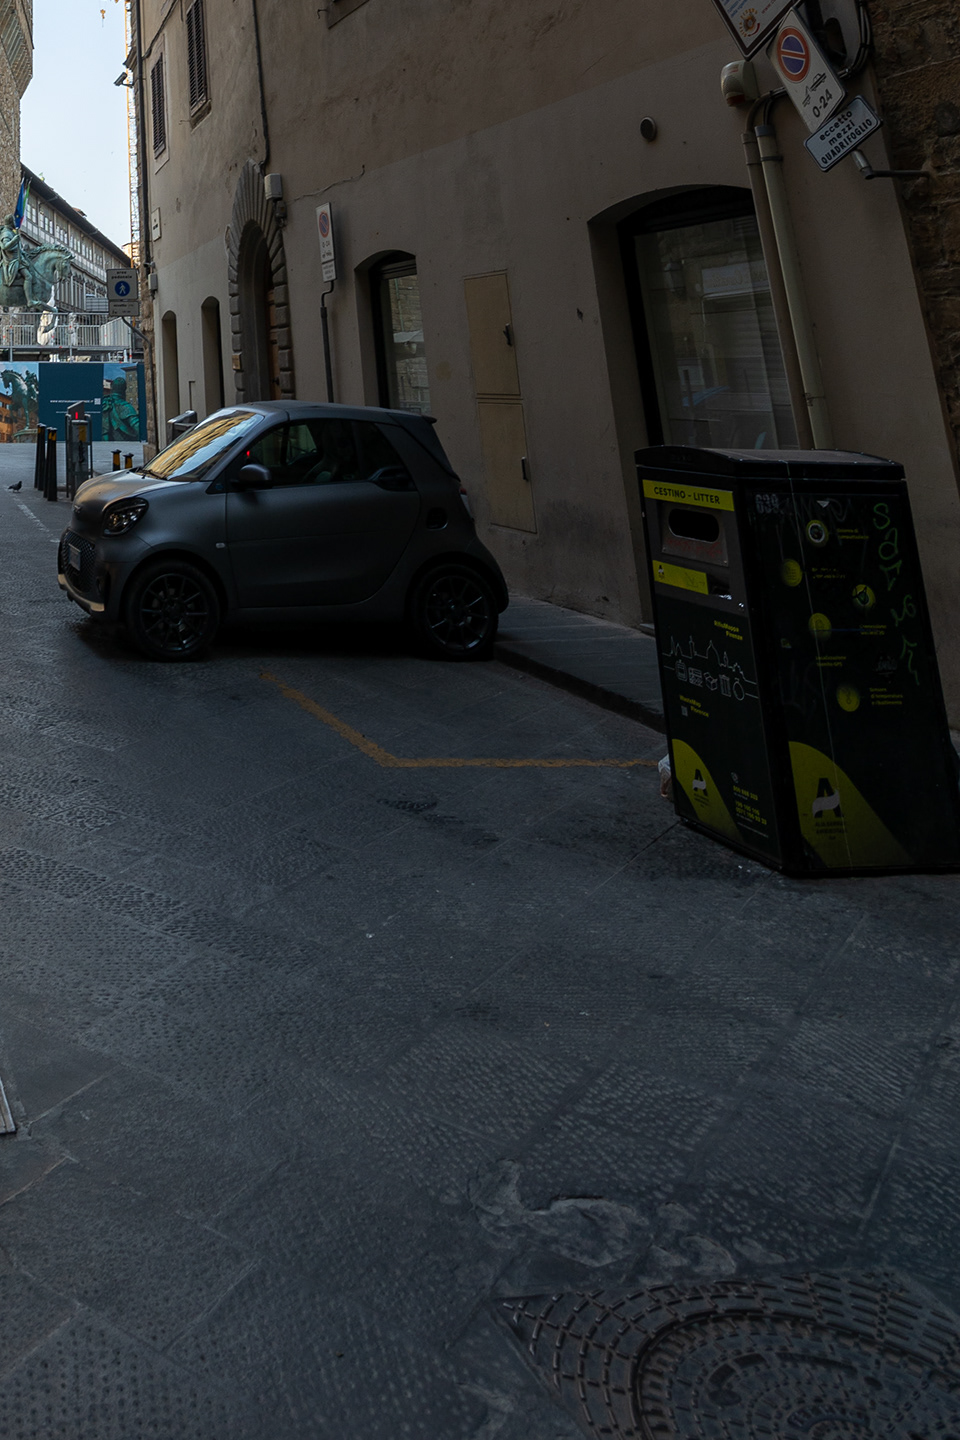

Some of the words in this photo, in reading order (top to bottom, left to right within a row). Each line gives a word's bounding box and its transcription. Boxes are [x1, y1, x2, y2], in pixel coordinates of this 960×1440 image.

[812, 89, 832, 118] 0-24
[819, 110, 852, 141] eccetto
[828, 120, 855, 146] mezzi
[821, 119, 872, 164] QUADRIFOGLIO
[654, 486, 686, 499] CESTINO
[693, 492, 720, 504] LITTER
